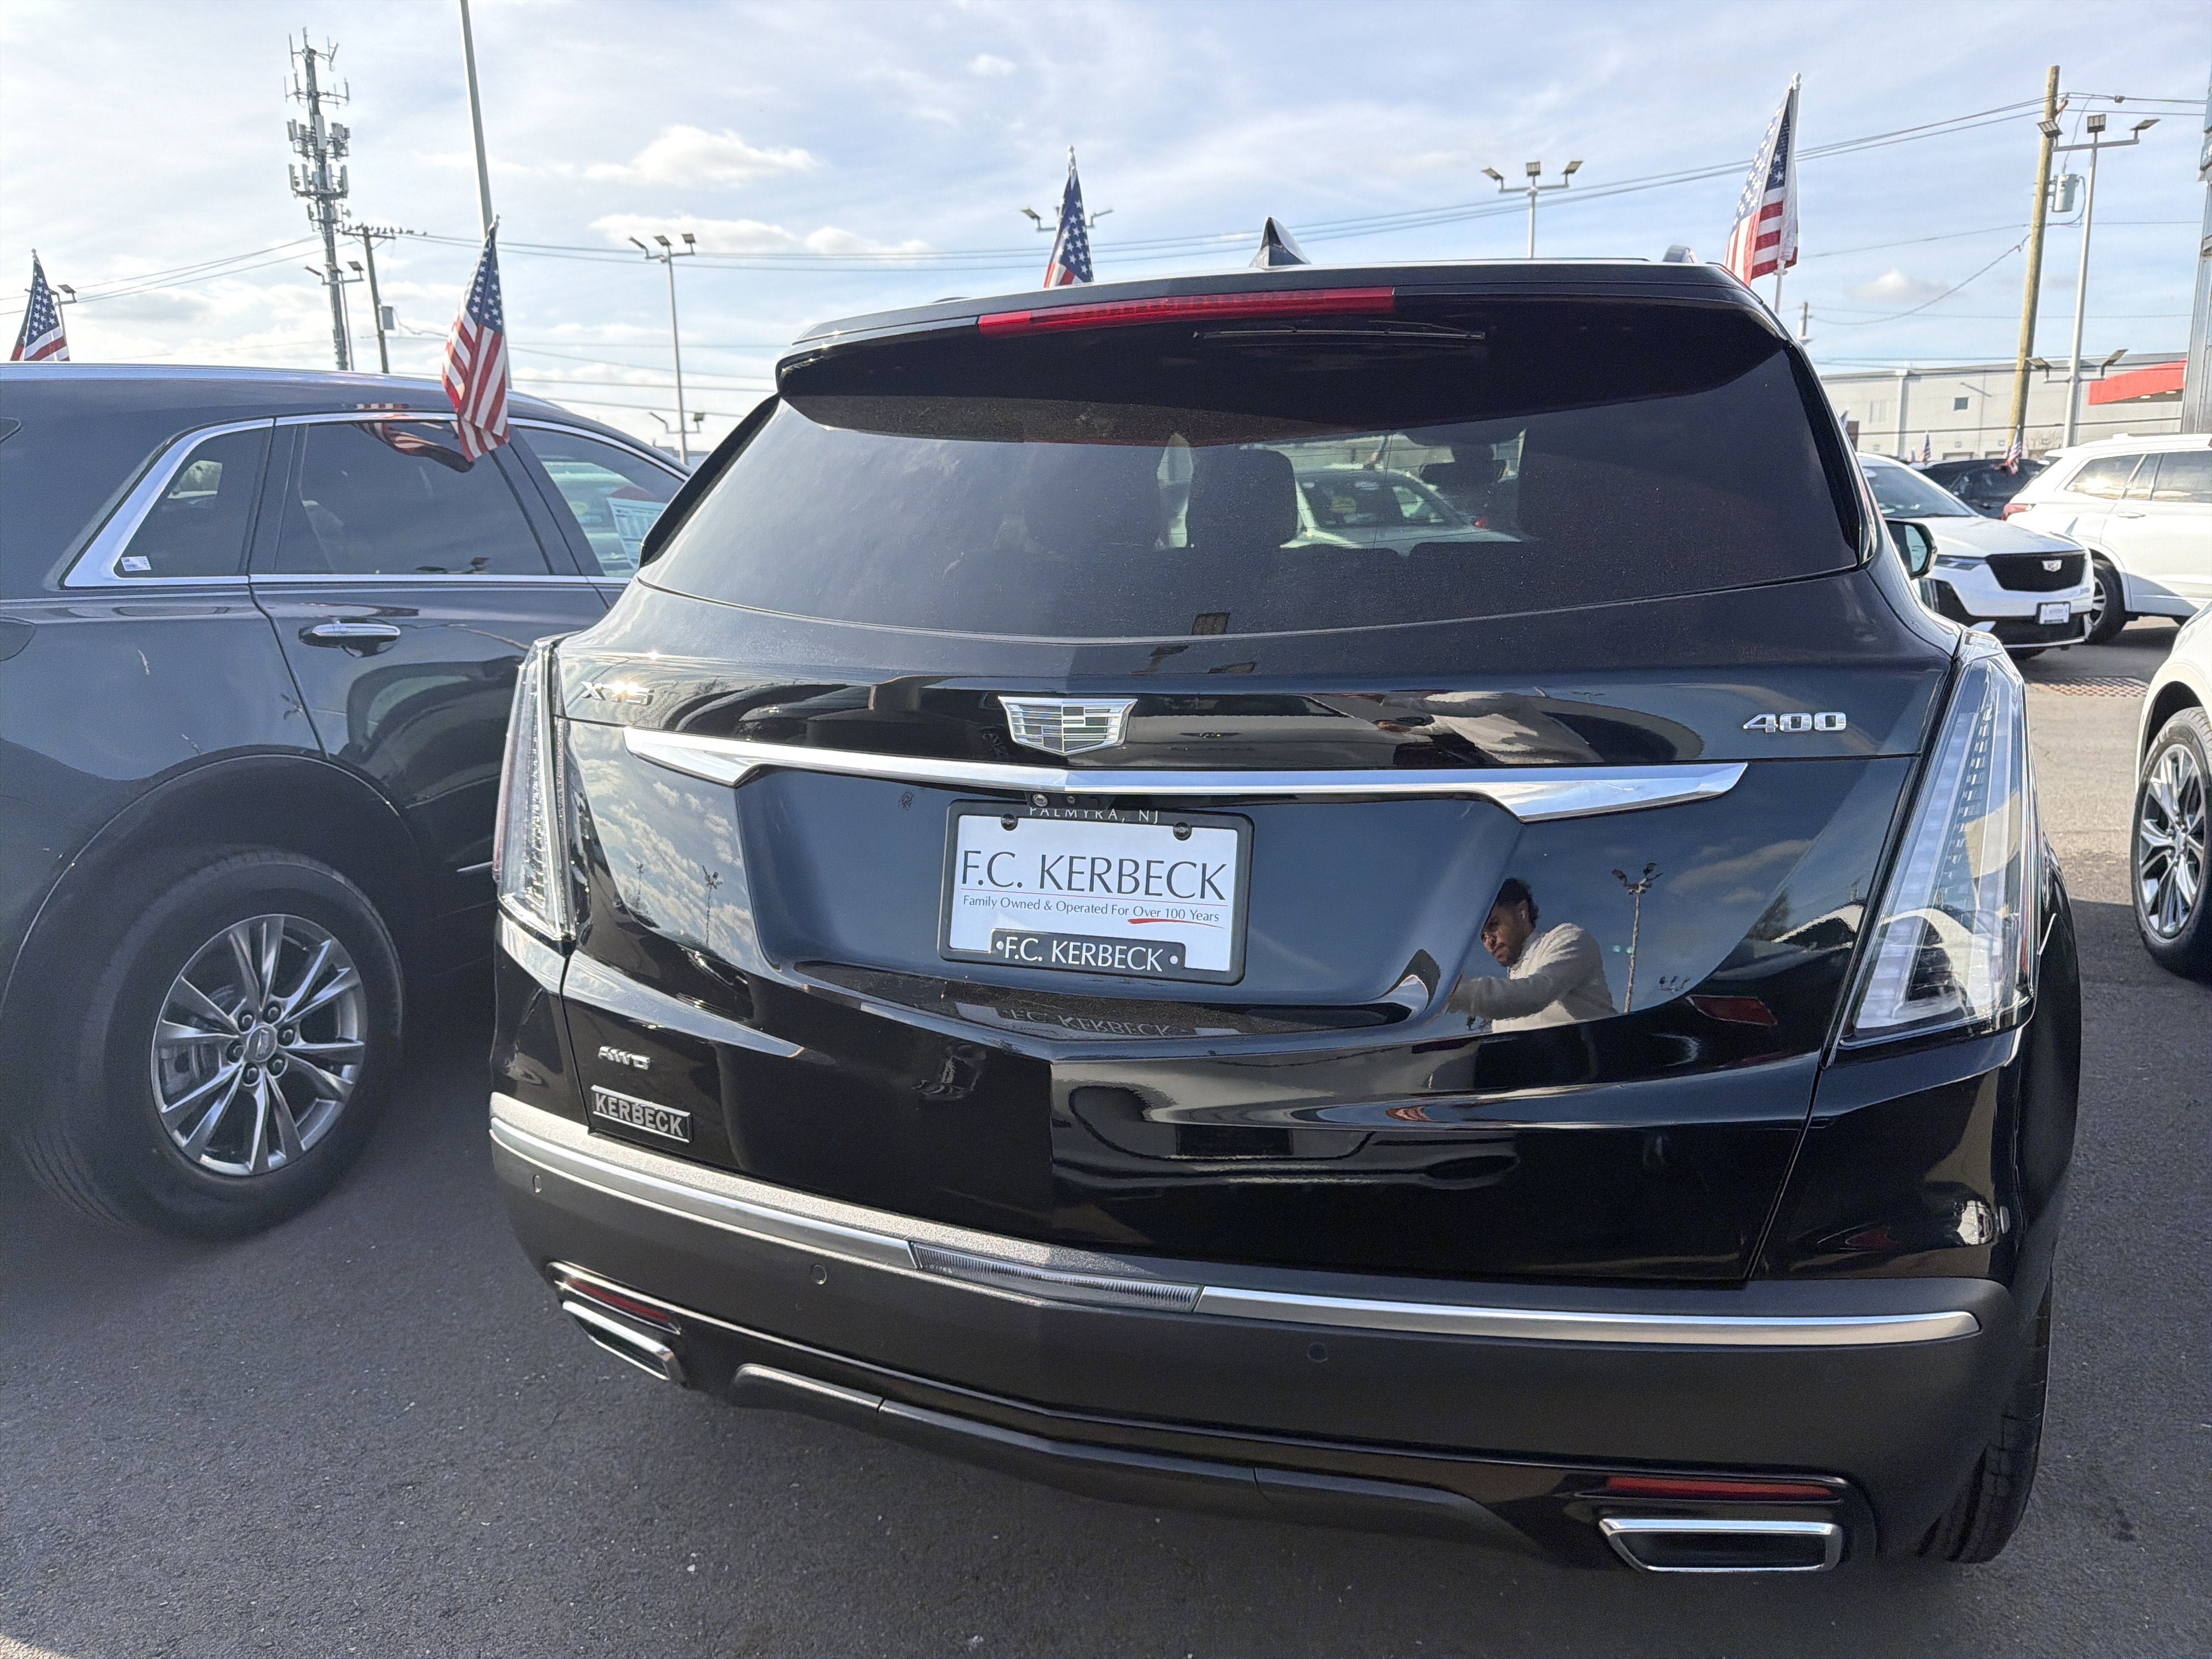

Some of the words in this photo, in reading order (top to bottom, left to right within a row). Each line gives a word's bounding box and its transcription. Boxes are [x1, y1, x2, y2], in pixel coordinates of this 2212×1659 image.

[1743, 712, 1847, 732] 400
[1030, 807, 1126, 823] PALMYRA,
[1138, 809, 1158, 824] NJ
[961, 850, 1023, 889] F.C.
[1040, 854, 1228, 901] KERBECK
[963, 895, 998, 910] Family
[1000, 897, 1040, 910] Owned
[1043, 900, 1052, 911] &
[1056, 900, 1108, 915] Operated
[1111, 904, 1130, 916] For
[1133, 906, 1161, 918] Over
[1165, 908, 1186, 919] 100
[1189, 909, 1219, 922] Years
[1003, 936, 1043, 962] F.C.
[1051, 940, 1164, 972] KERBECK
[598, 1045, 651, 1070] AWD
[595, 1092, 684, 1137] KERBECK
